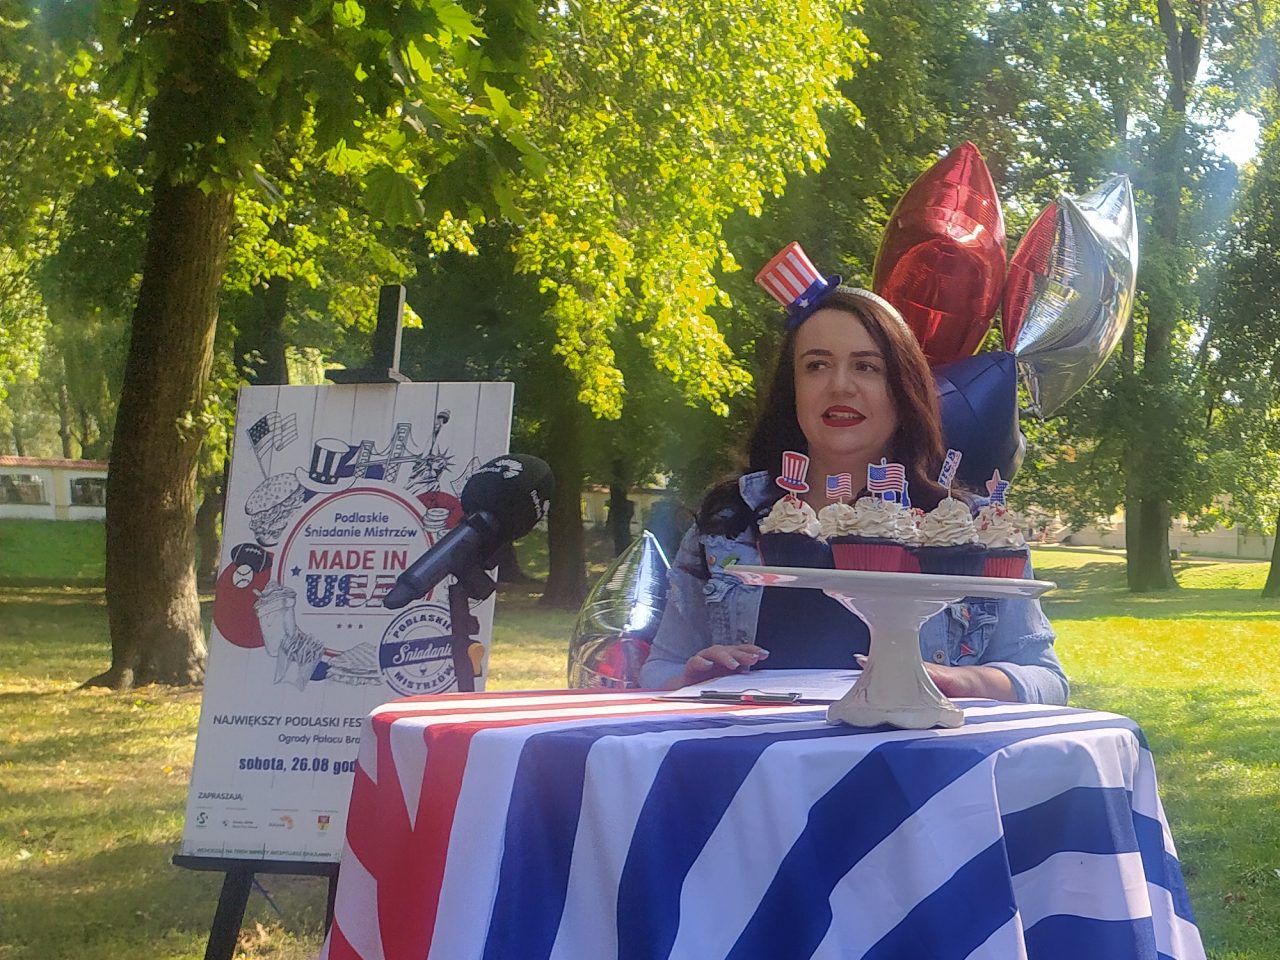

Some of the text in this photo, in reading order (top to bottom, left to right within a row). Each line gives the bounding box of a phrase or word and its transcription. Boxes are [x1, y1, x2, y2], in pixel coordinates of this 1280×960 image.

[334, 512, 389, 523] Podlaskie
[304, 524, 418, 538] Śniadanie Mistrzów
[308, 550, 408, 570] MADE IN
[213, 714, 366, 729] NAJWIĘKSZY PODLASKI FES
[278, 733, 311, 746] Ogrody
[313, 733, 343, 744] Pałacu
[239, 757, 287, 772] sobota,
[291, 757, 329, 772] 26.08
